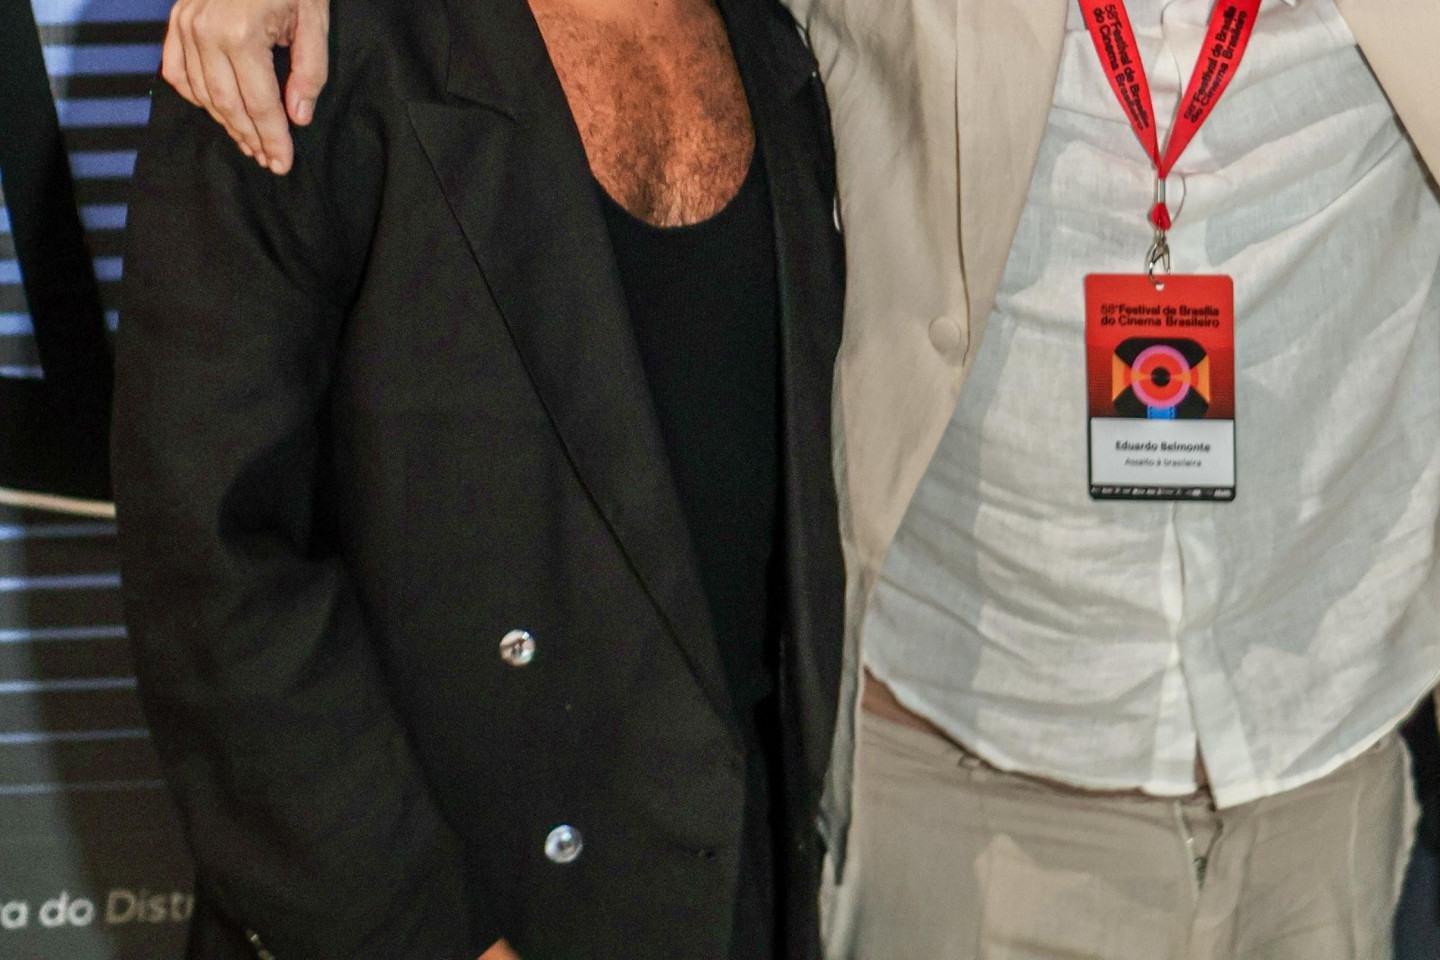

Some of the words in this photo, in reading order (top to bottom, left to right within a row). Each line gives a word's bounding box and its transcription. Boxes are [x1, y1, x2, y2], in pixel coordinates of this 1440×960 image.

[1093, 6, 1106, 24] do
[1098, 24, 1119, 71] Cinema
[1124, 66, 1136, 83] de
[1190, 108, 1204, 124] do
[1200, 62, 1229, 107] Cinema
[1221, 10, 1248, 60] Brasileiro
[1162, 305, 1176, 315] de
[1101, 315, 1116, 326] do
[1118, 315, 1162, 327] Cinema
[1165, 316, 1220, 328] Brasileiro
[1115, 440, 1158, 451] Eduardo
[1160, 441, 1211, 452] Belmonte
[38, 890, 95, 927] do
